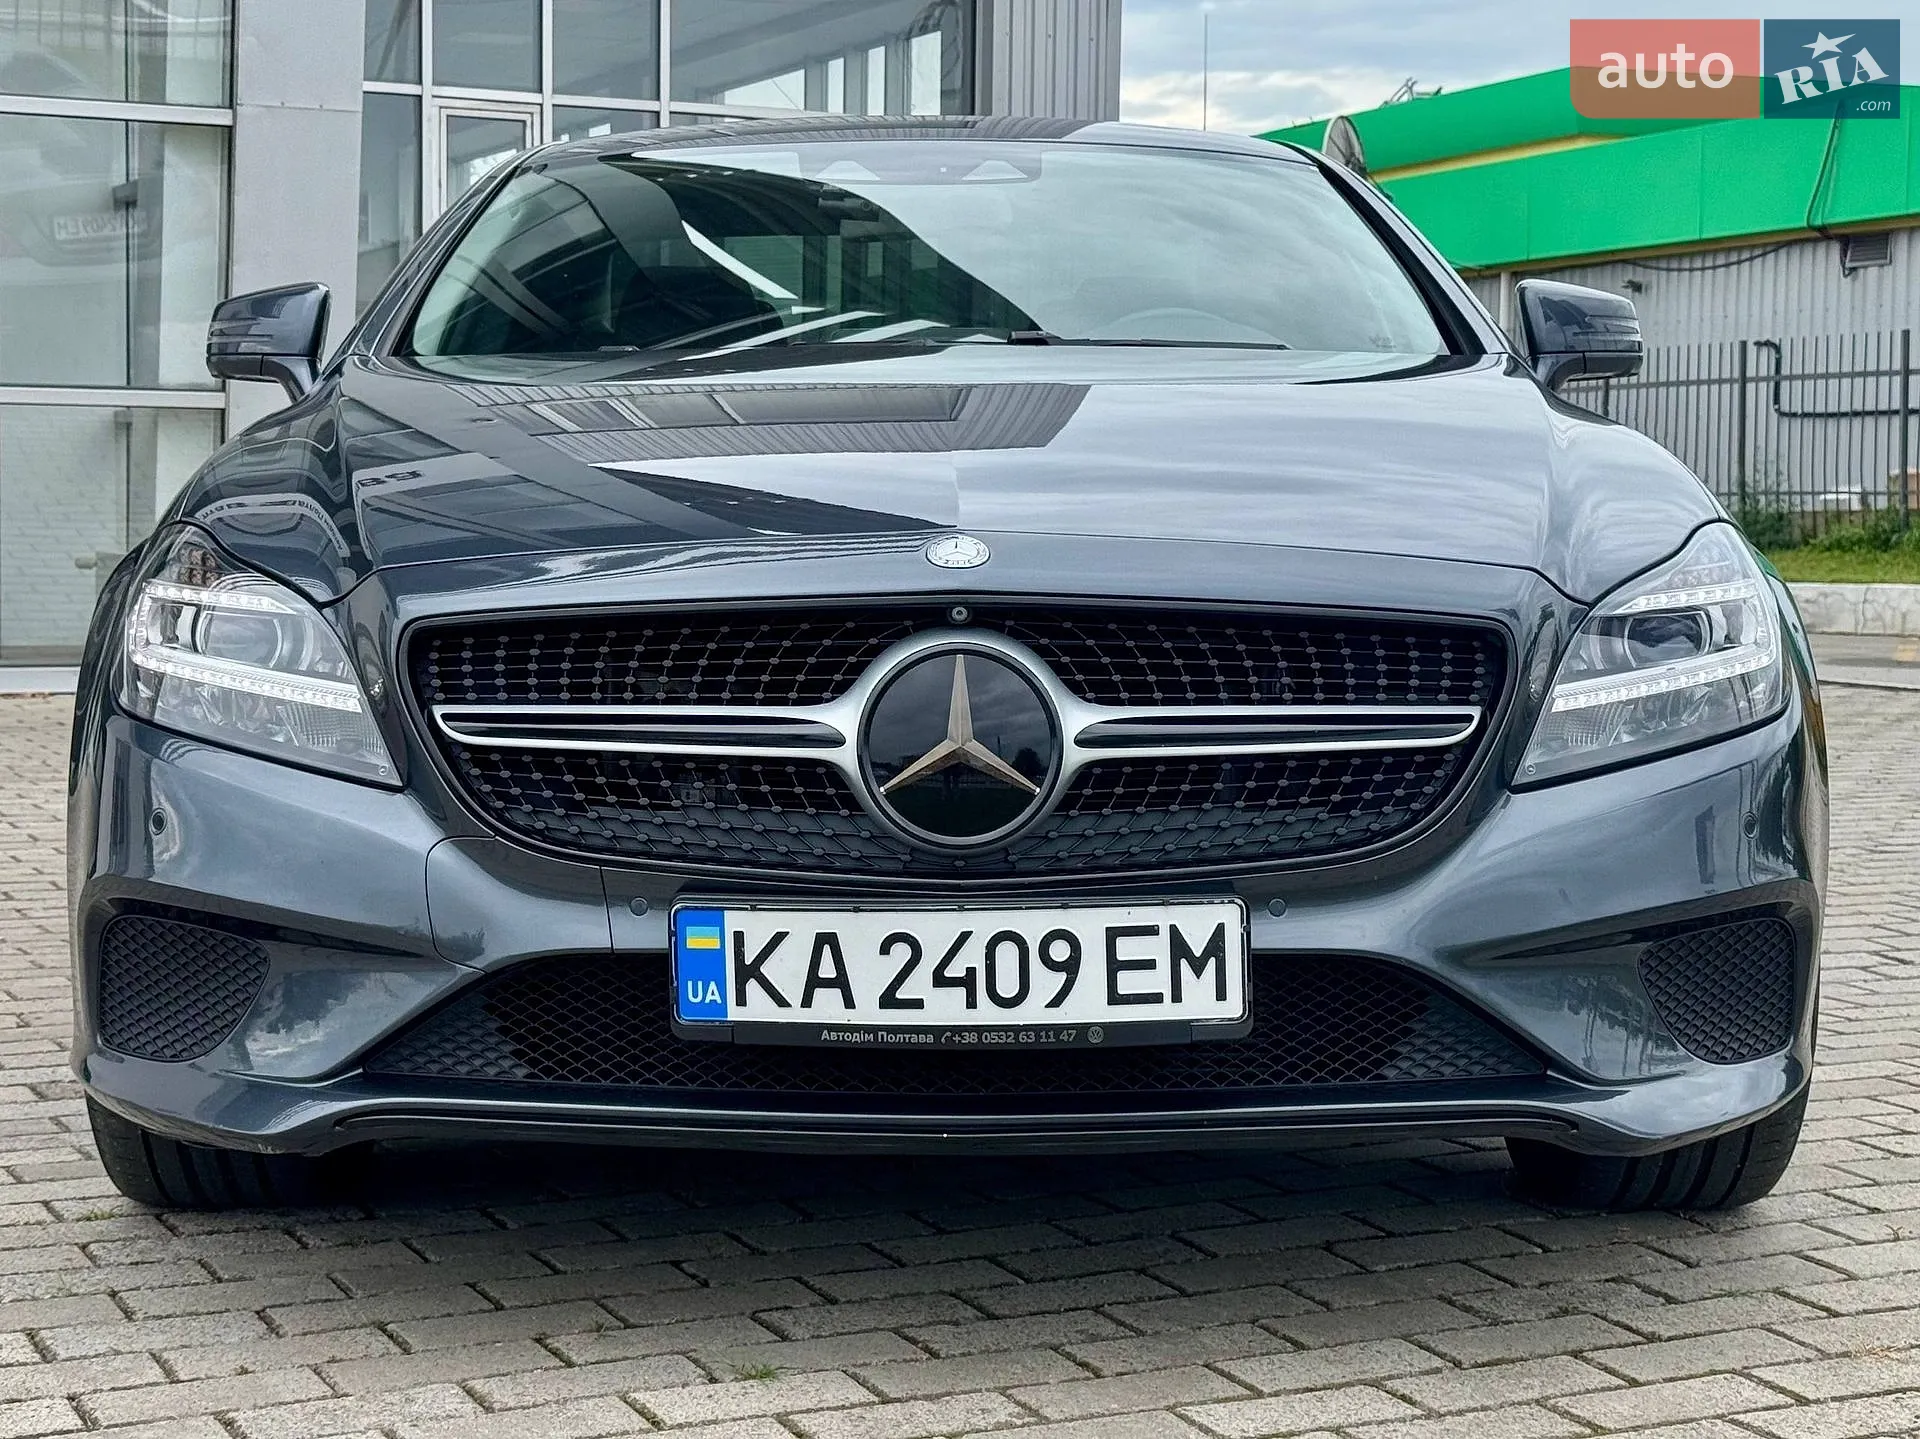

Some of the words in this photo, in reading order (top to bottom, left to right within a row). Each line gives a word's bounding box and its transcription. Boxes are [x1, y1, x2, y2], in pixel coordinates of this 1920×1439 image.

[732, 930, 856, 1009] KA
[878, 929, 1083, 1010] 2409
[1105, 922, 1227, 1006] EM
[687, 981, 722, 1004] UA
[821, 1029, 874, 1043] Автодім
[878, 1031, 934, 1043] Полтава
[952, 1031, 978, 1044] +38
[981, 1031, 1015, 1043] 0532
[1018, 1031, 1036, 1043] 63
[1039, 1030, 1056, 1042] 11
[1059, 1029, 1077, 1042] 47
